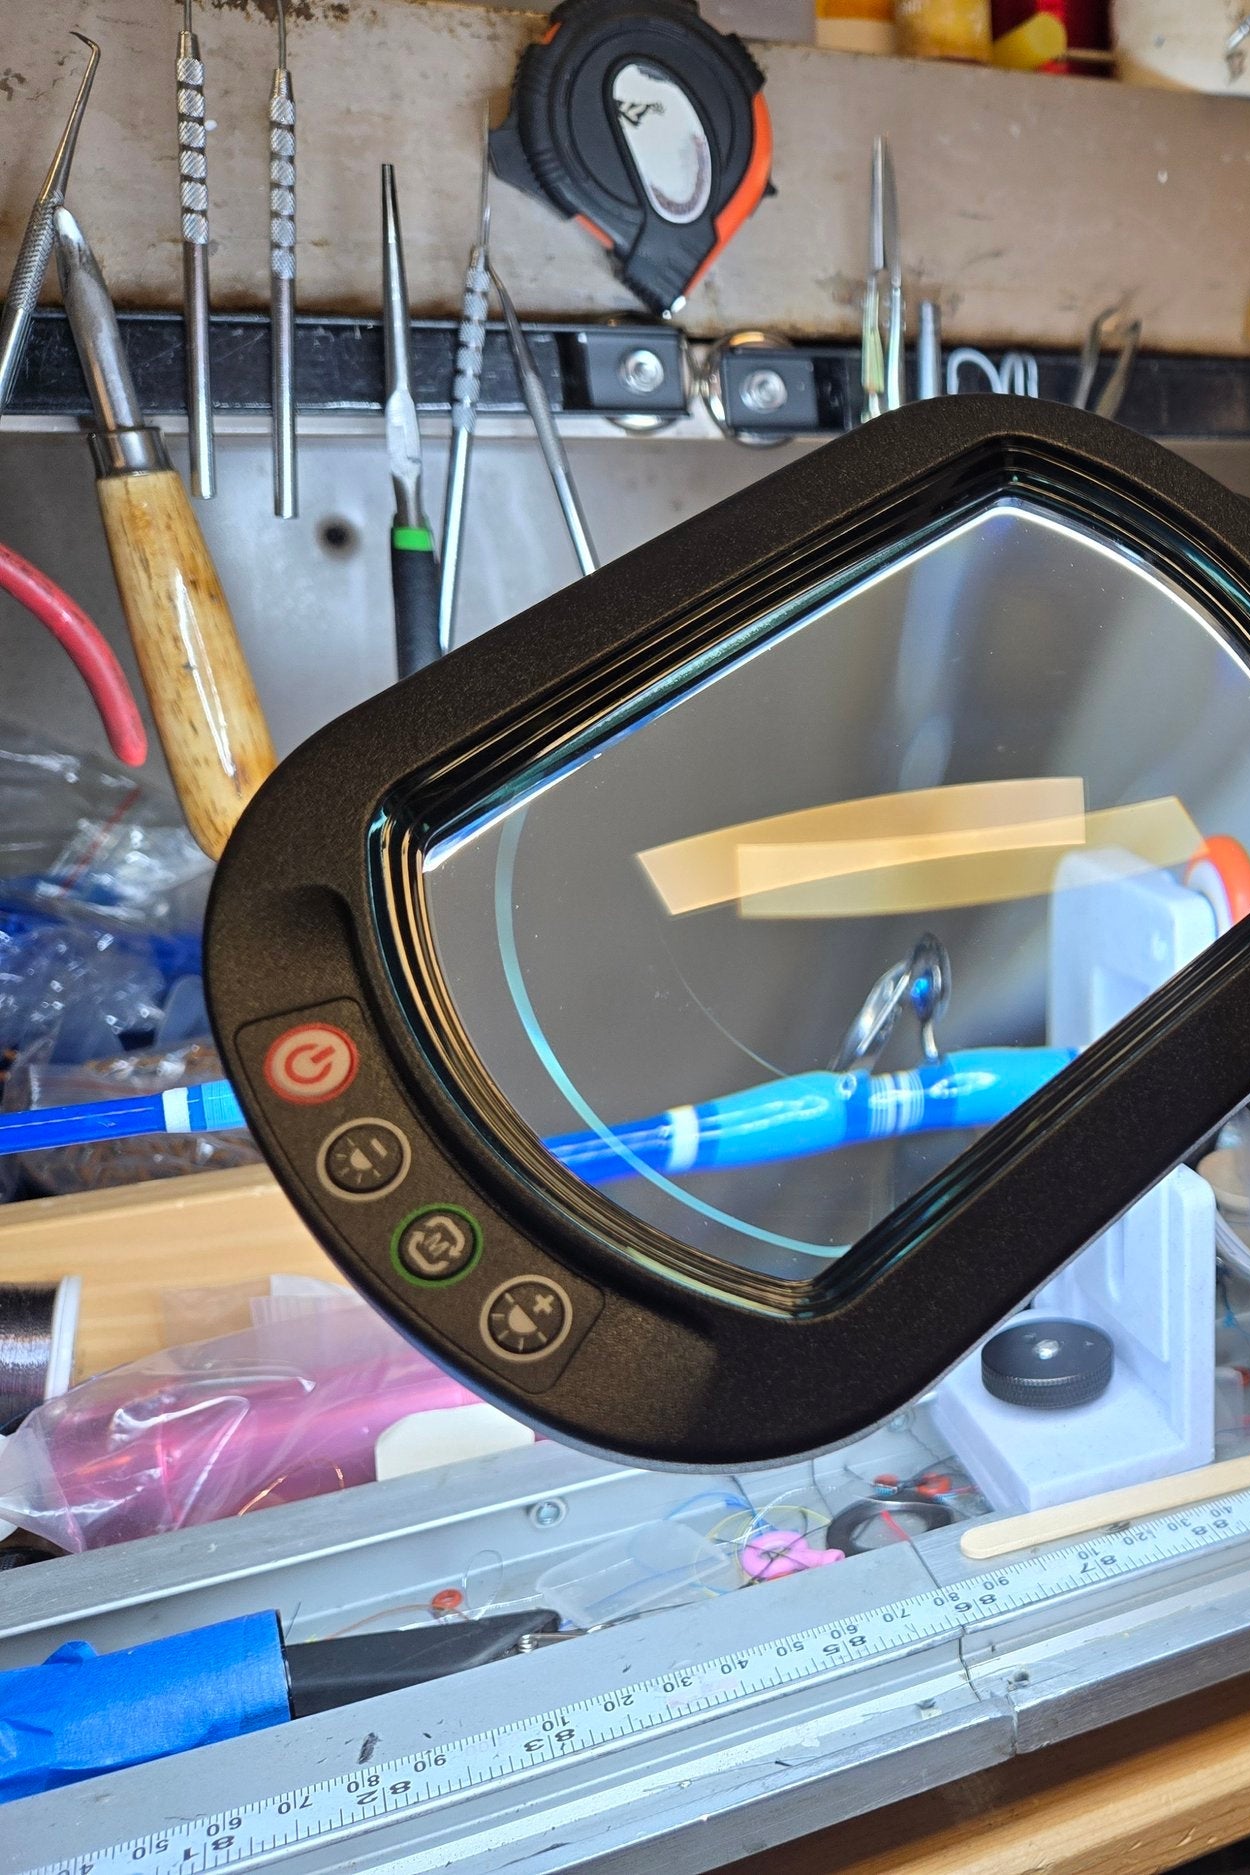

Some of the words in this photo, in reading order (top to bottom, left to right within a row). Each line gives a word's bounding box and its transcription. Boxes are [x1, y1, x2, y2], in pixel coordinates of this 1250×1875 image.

[1209, 1505, 1234, 1519] 40
[1166, 1518, 1193, 1532] 30
[1191, 1519, 1230, 1536] 88
[1077, 1547, 1101, 1560] 10
[1080, 1555, 1118, 1574] 87
[983, 1576, 1011, 1591] 90
[933, 1592, 961, 1607] 80
[954, 1593, 999, 1614] 86
[882, 1607, 913, 1623] 70
[830, 1624, 859, 1640] 60
[776, 1641, 806, 1657] 50
[823, 1635, 867, 1657] 85
[720, 1659, 750, 1675] 40
[664, 1675, 694, 1694] 30
[603, 1694, 635, 1713] 20
[542, 1715, 571, 1733] 10
[523, 1728, 576, 1753] 83
[414, 1753, 448, 1773] 90
[347, 1774, 381, 1794] 80
[357, 1780, 412, 1806] 82
[278, 1795, 314, 1815] 70
[207, 1816, 243, 1837] 60
[132, 1839, 169, 1861] 50
[183, 1835, 236, 1862] 81
